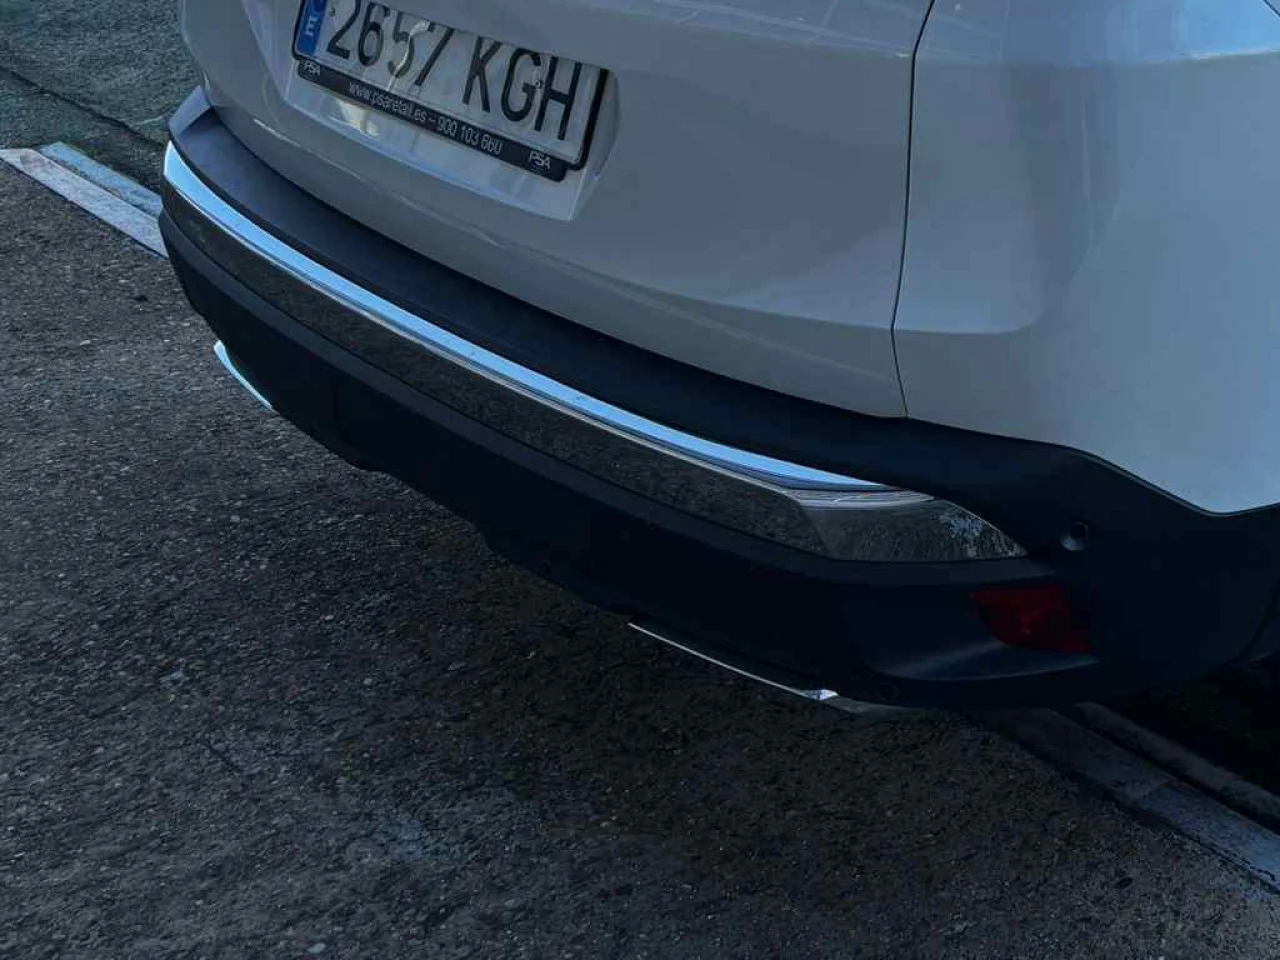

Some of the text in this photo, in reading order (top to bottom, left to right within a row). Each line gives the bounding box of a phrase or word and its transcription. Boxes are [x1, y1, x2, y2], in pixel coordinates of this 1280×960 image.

[462, 35, 583, 141] KGH
[438, 116, 458, 137] 900
[460, 125, 480, 146] 103
[529, 150, 551, 171] PSA
